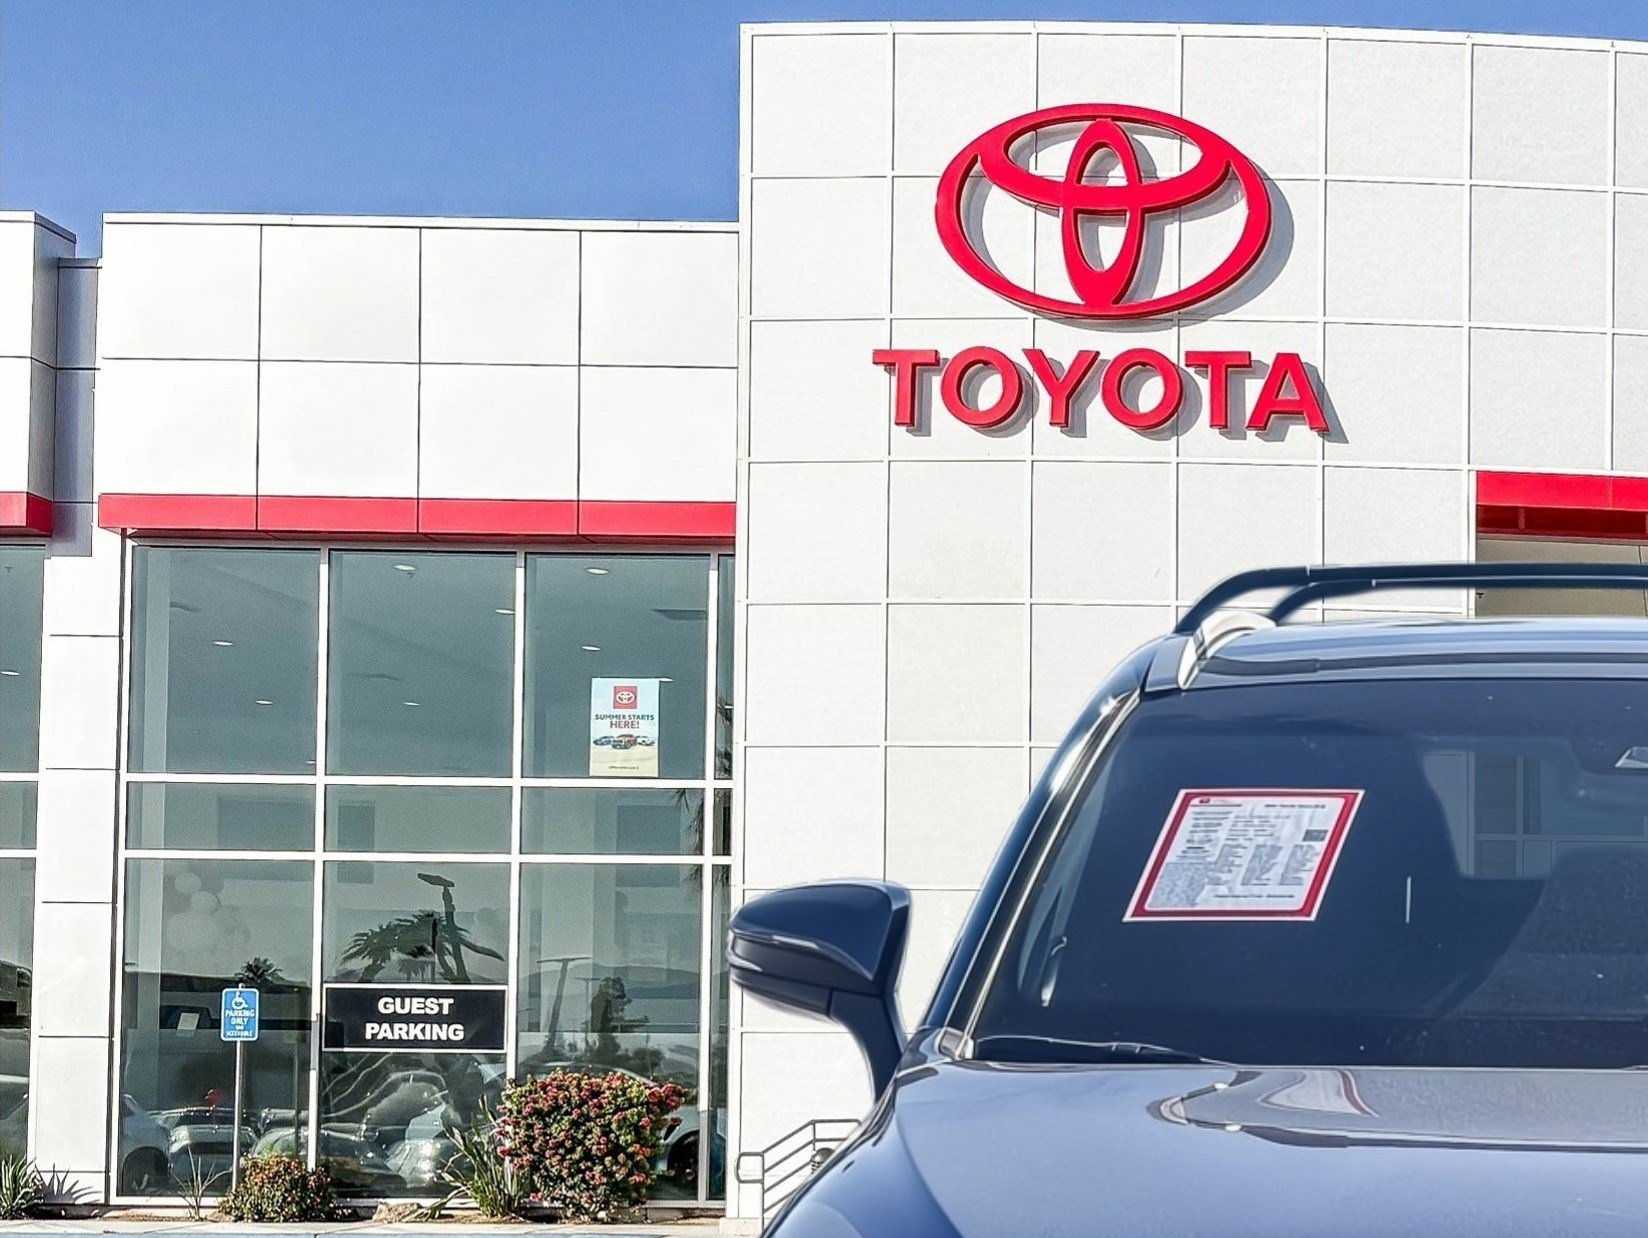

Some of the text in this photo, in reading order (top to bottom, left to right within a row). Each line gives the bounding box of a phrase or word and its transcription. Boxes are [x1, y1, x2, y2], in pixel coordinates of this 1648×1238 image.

[872, 345, 1329, 433] TOYOTA
[609, 721, 640, 729] HERE!
[225, 1009, 255, 1017] PARKING
[377, 996, 455, 1015] GUEST
[365, 1023, 465, 1041] PARKING
